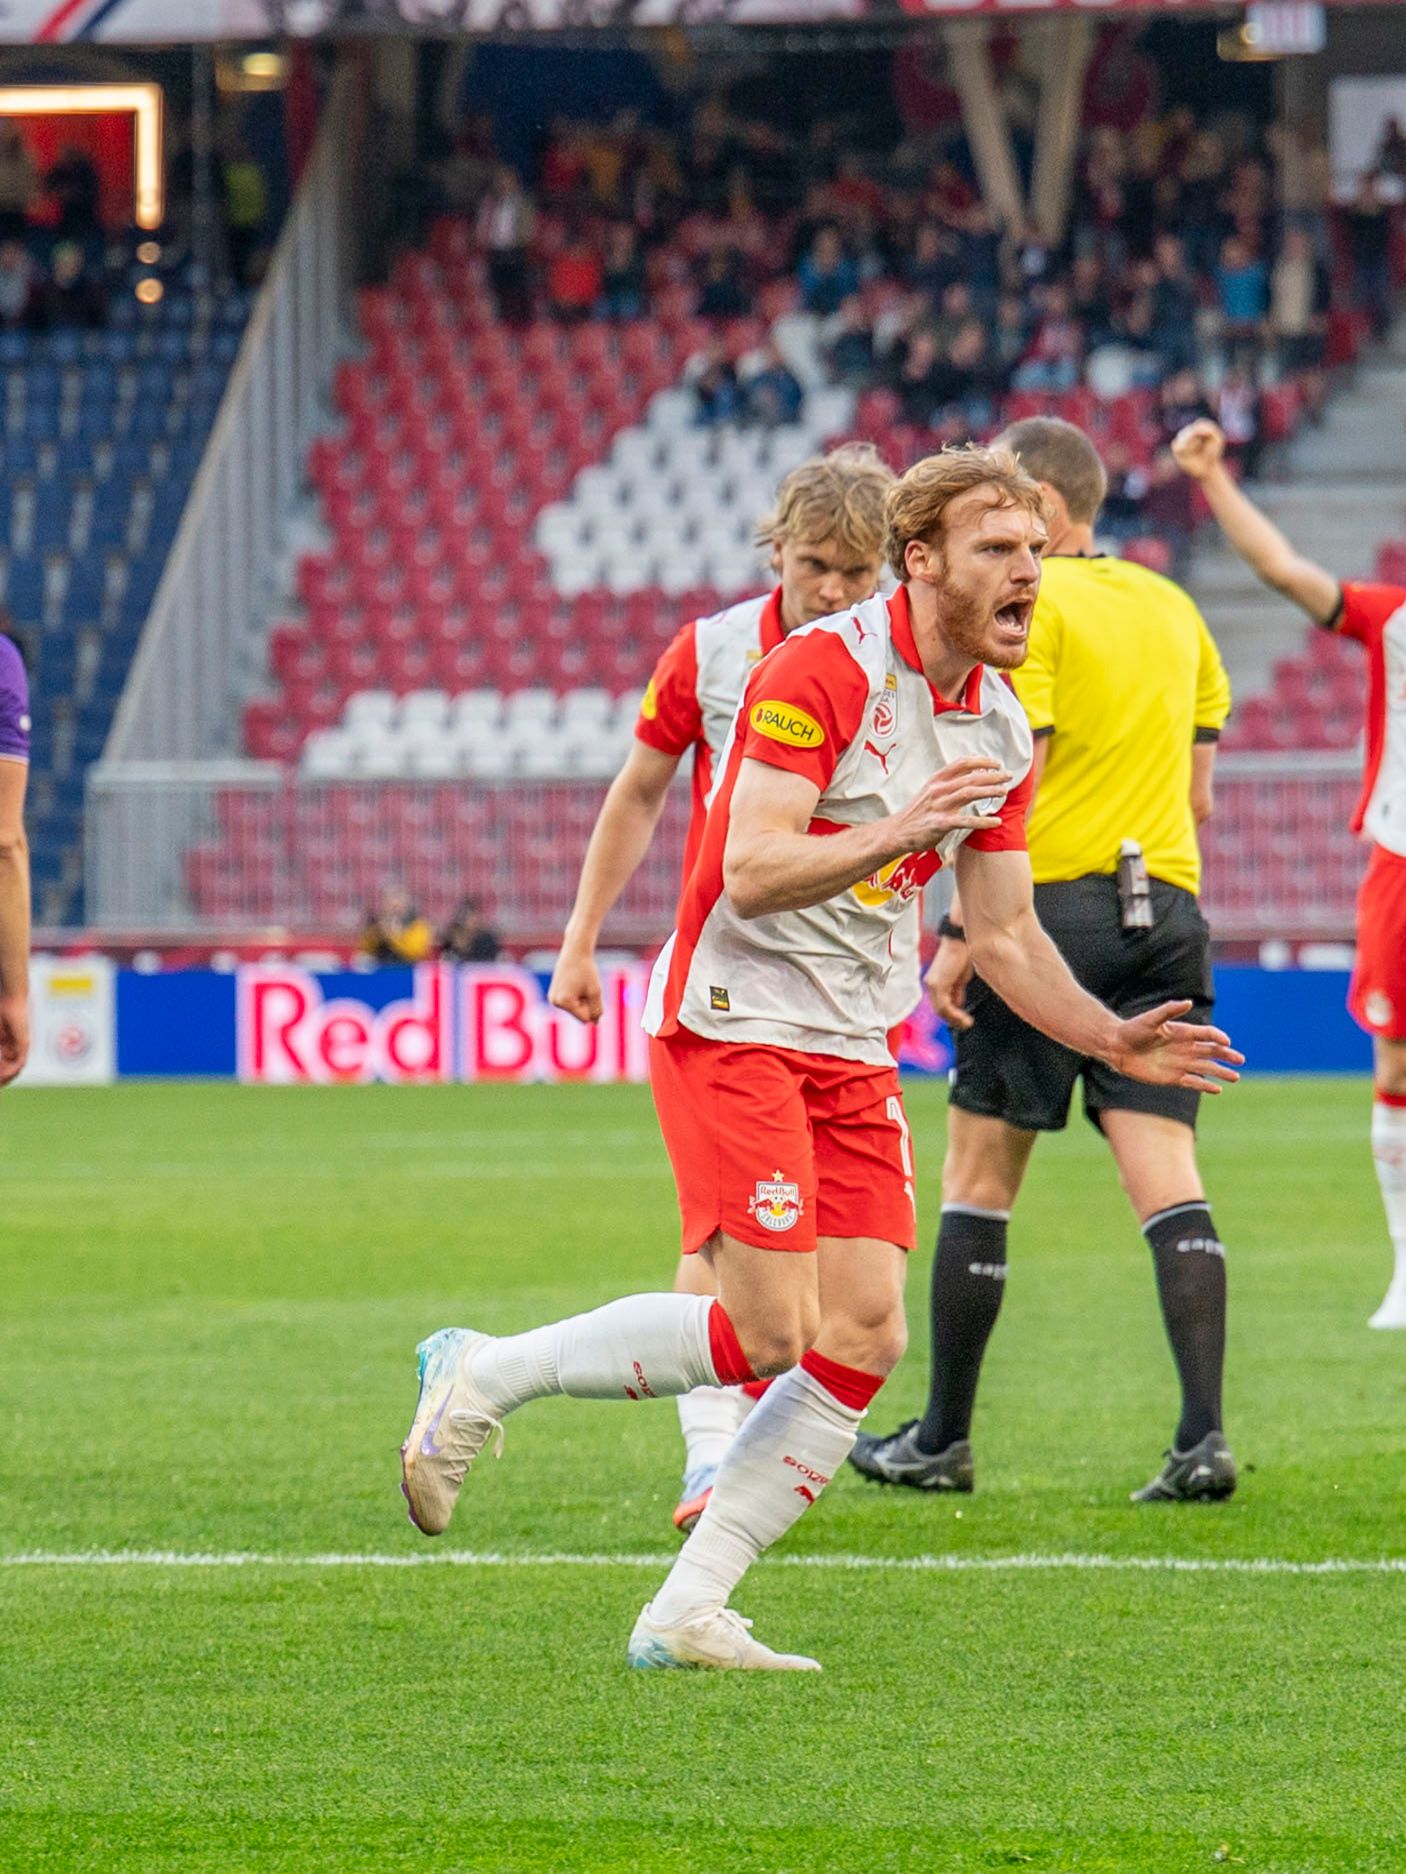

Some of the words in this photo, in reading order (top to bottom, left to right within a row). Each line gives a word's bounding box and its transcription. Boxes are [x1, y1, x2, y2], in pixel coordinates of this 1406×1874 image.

[764, 709, 815, 741] RAUCH
[248, 957, 446, 1076] Red
[473, 962, 650, 1076] Bul
